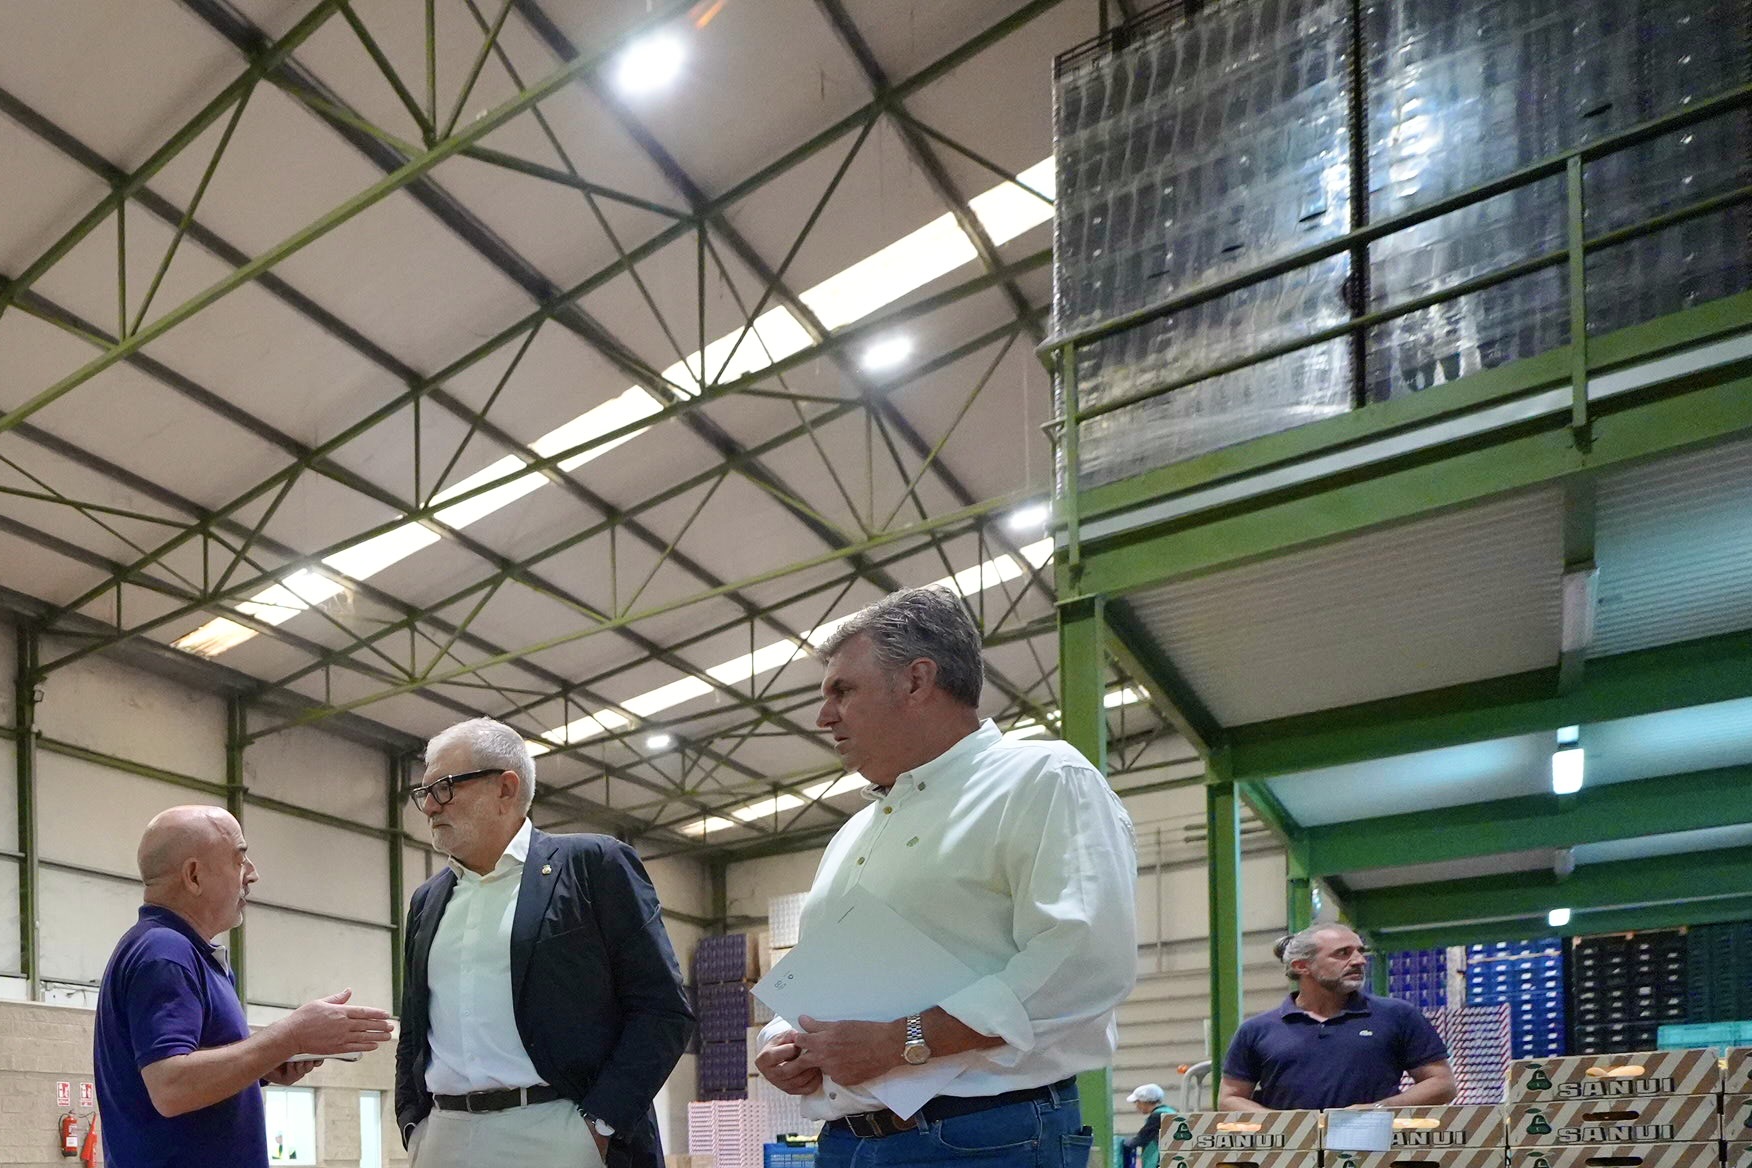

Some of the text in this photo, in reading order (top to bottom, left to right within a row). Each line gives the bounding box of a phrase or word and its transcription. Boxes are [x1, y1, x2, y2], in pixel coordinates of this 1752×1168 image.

[1557, 1077, 1676, 1098] SANUI
[1197, 1134, 1285, 1149] SANUI
[1392, 1130, 1466, 1146] ANUI
[1556, 1124, 1675, 1143] SANUI
